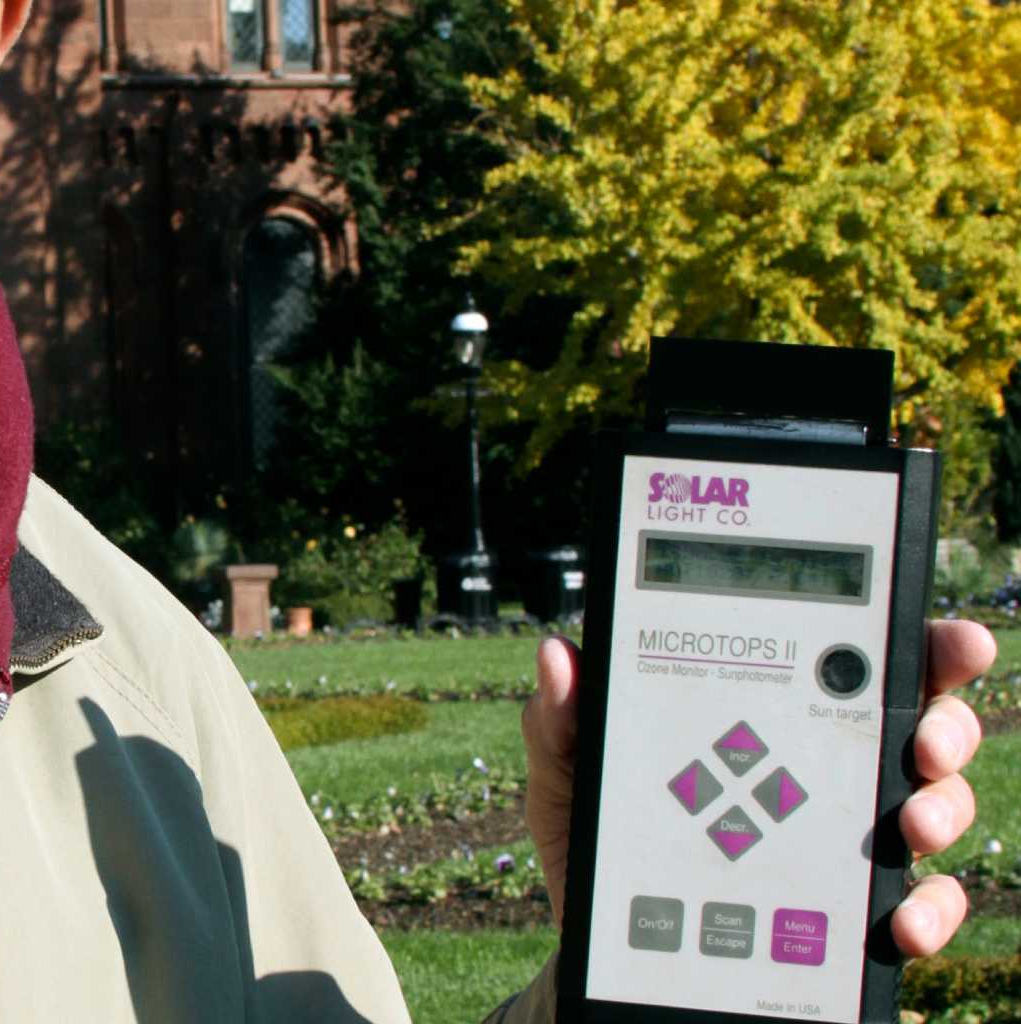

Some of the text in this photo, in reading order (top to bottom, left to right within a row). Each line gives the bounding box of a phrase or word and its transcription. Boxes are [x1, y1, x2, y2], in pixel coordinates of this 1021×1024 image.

[648, 472, 750, 507] SOLAR
[647, 505, 707, 523] LIGHT
[638, 629, 797, 661] MICROTOPS II
[637, 661, 671, 675] Ozone
[673, 663, 708, 678] Monitor
[717, 667, 794, 684] Sunphotometer
[809, 703, 871, 724] Sun target
[638, 918, 675, 931] On/Off
[714, 913, 742, 926] Scan
[785, 920, 816, 934] Menu
[707, 934, 747, 949] Escape
[783, 941, 813, 954] Enter
[756, 999, 783, 1012] Made
[798, 1002, 821, 1015] USA
